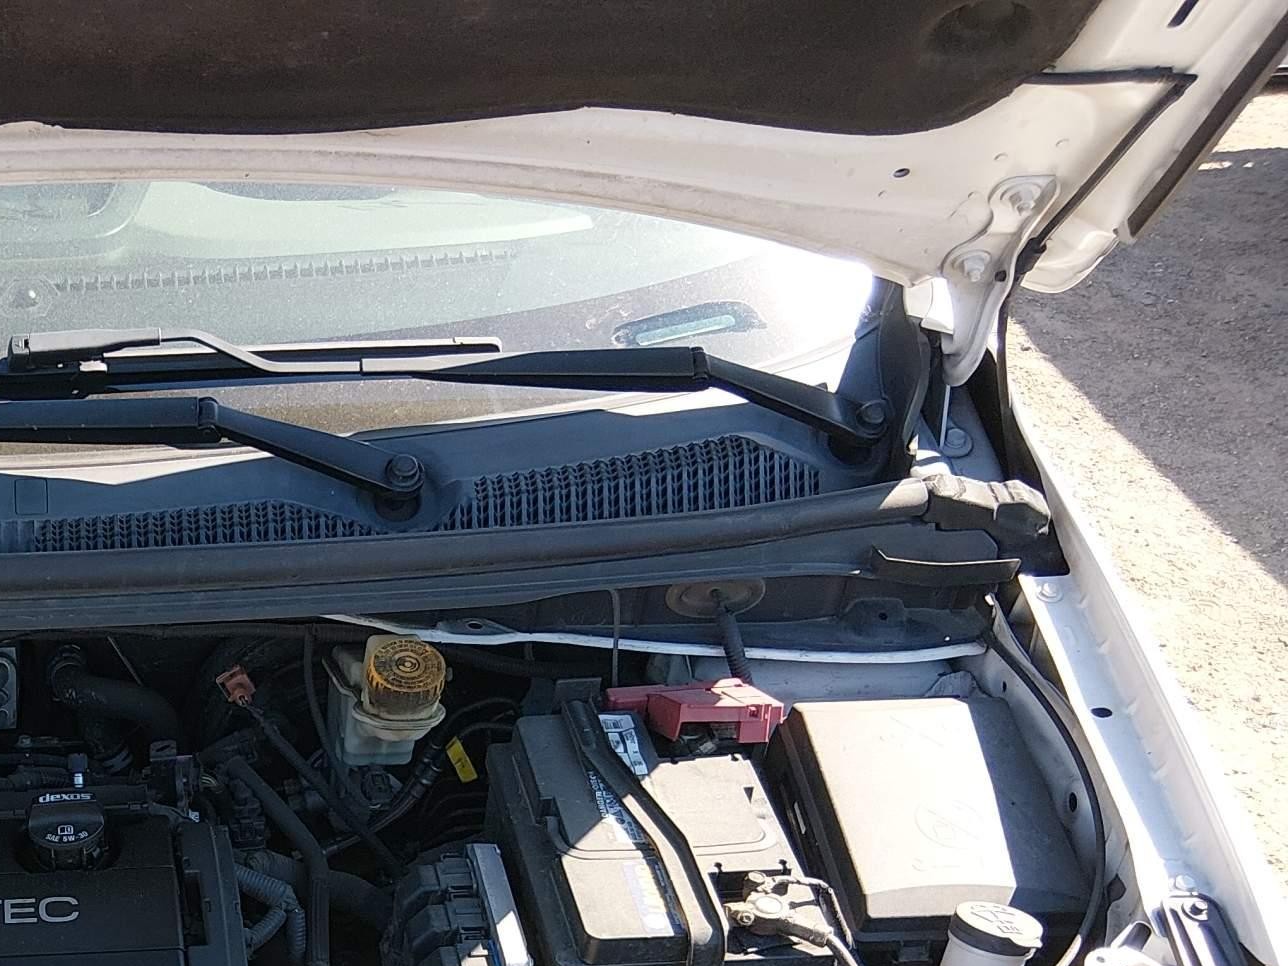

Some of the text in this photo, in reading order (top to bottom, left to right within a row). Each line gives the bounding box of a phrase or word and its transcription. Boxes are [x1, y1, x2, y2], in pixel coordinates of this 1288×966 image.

[38, 793, 94, 803] dexos
[45, 831, 89, 842] SAE 5W-30
